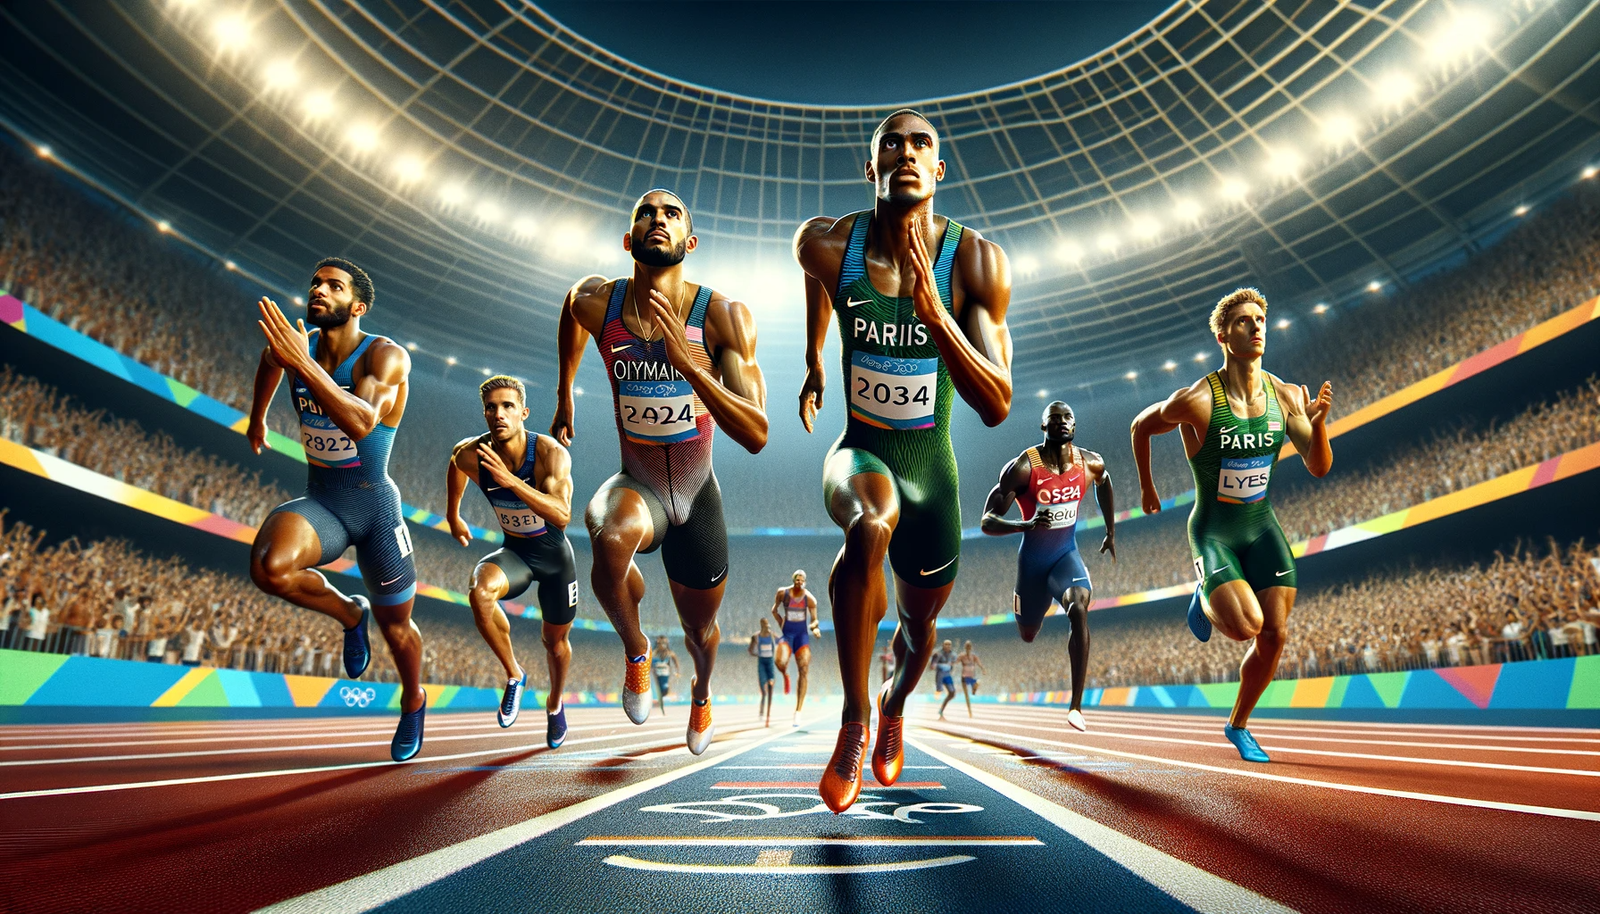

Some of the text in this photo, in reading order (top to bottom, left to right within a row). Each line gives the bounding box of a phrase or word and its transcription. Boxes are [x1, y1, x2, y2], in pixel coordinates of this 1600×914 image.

[857, 376, 930, 406] 2034
[1220, 432, 1274, 449] PARIS
[1223, 473, 1268, 489] LYES
